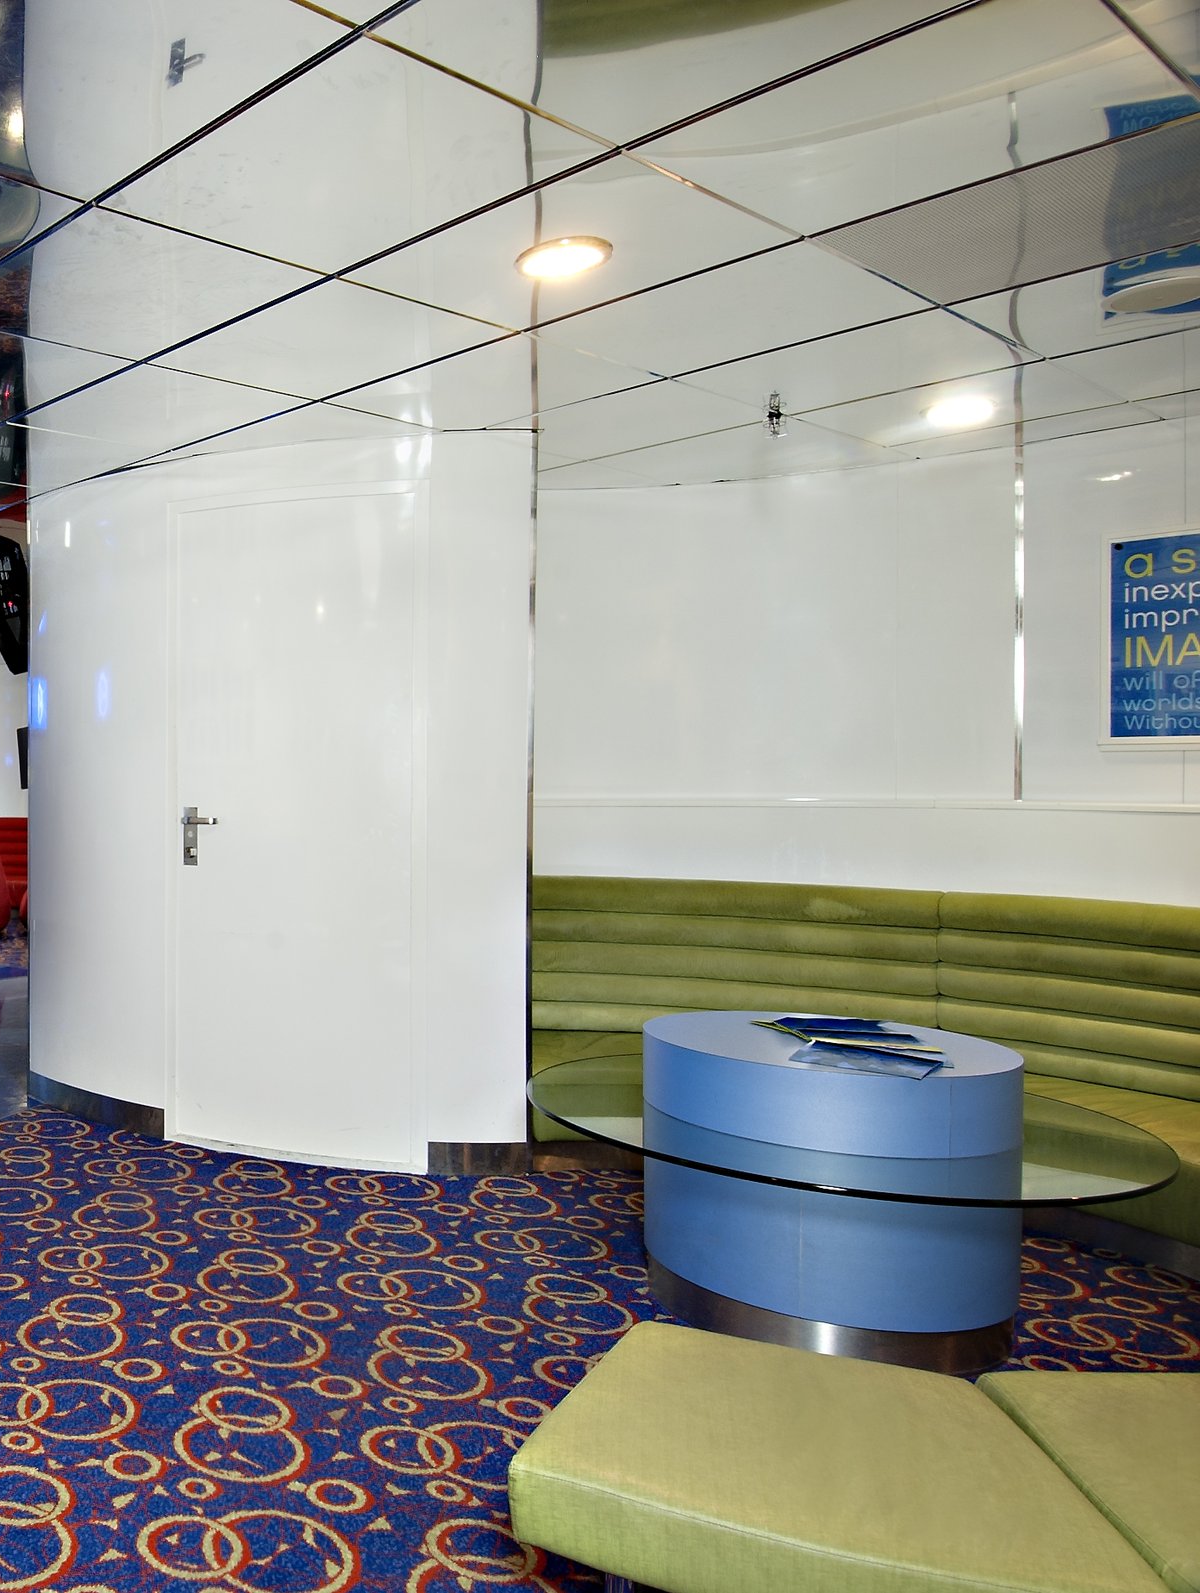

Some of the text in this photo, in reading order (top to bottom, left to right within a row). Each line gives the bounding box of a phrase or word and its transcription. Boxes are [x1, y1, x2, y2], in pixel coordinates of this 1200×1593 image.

[1124, 548, 1197, 578] a s
[1124, 608, 1199, 632] impr
[1125, 632, 1200, 668] IMA
[1123, 670, 1164, 691] will
